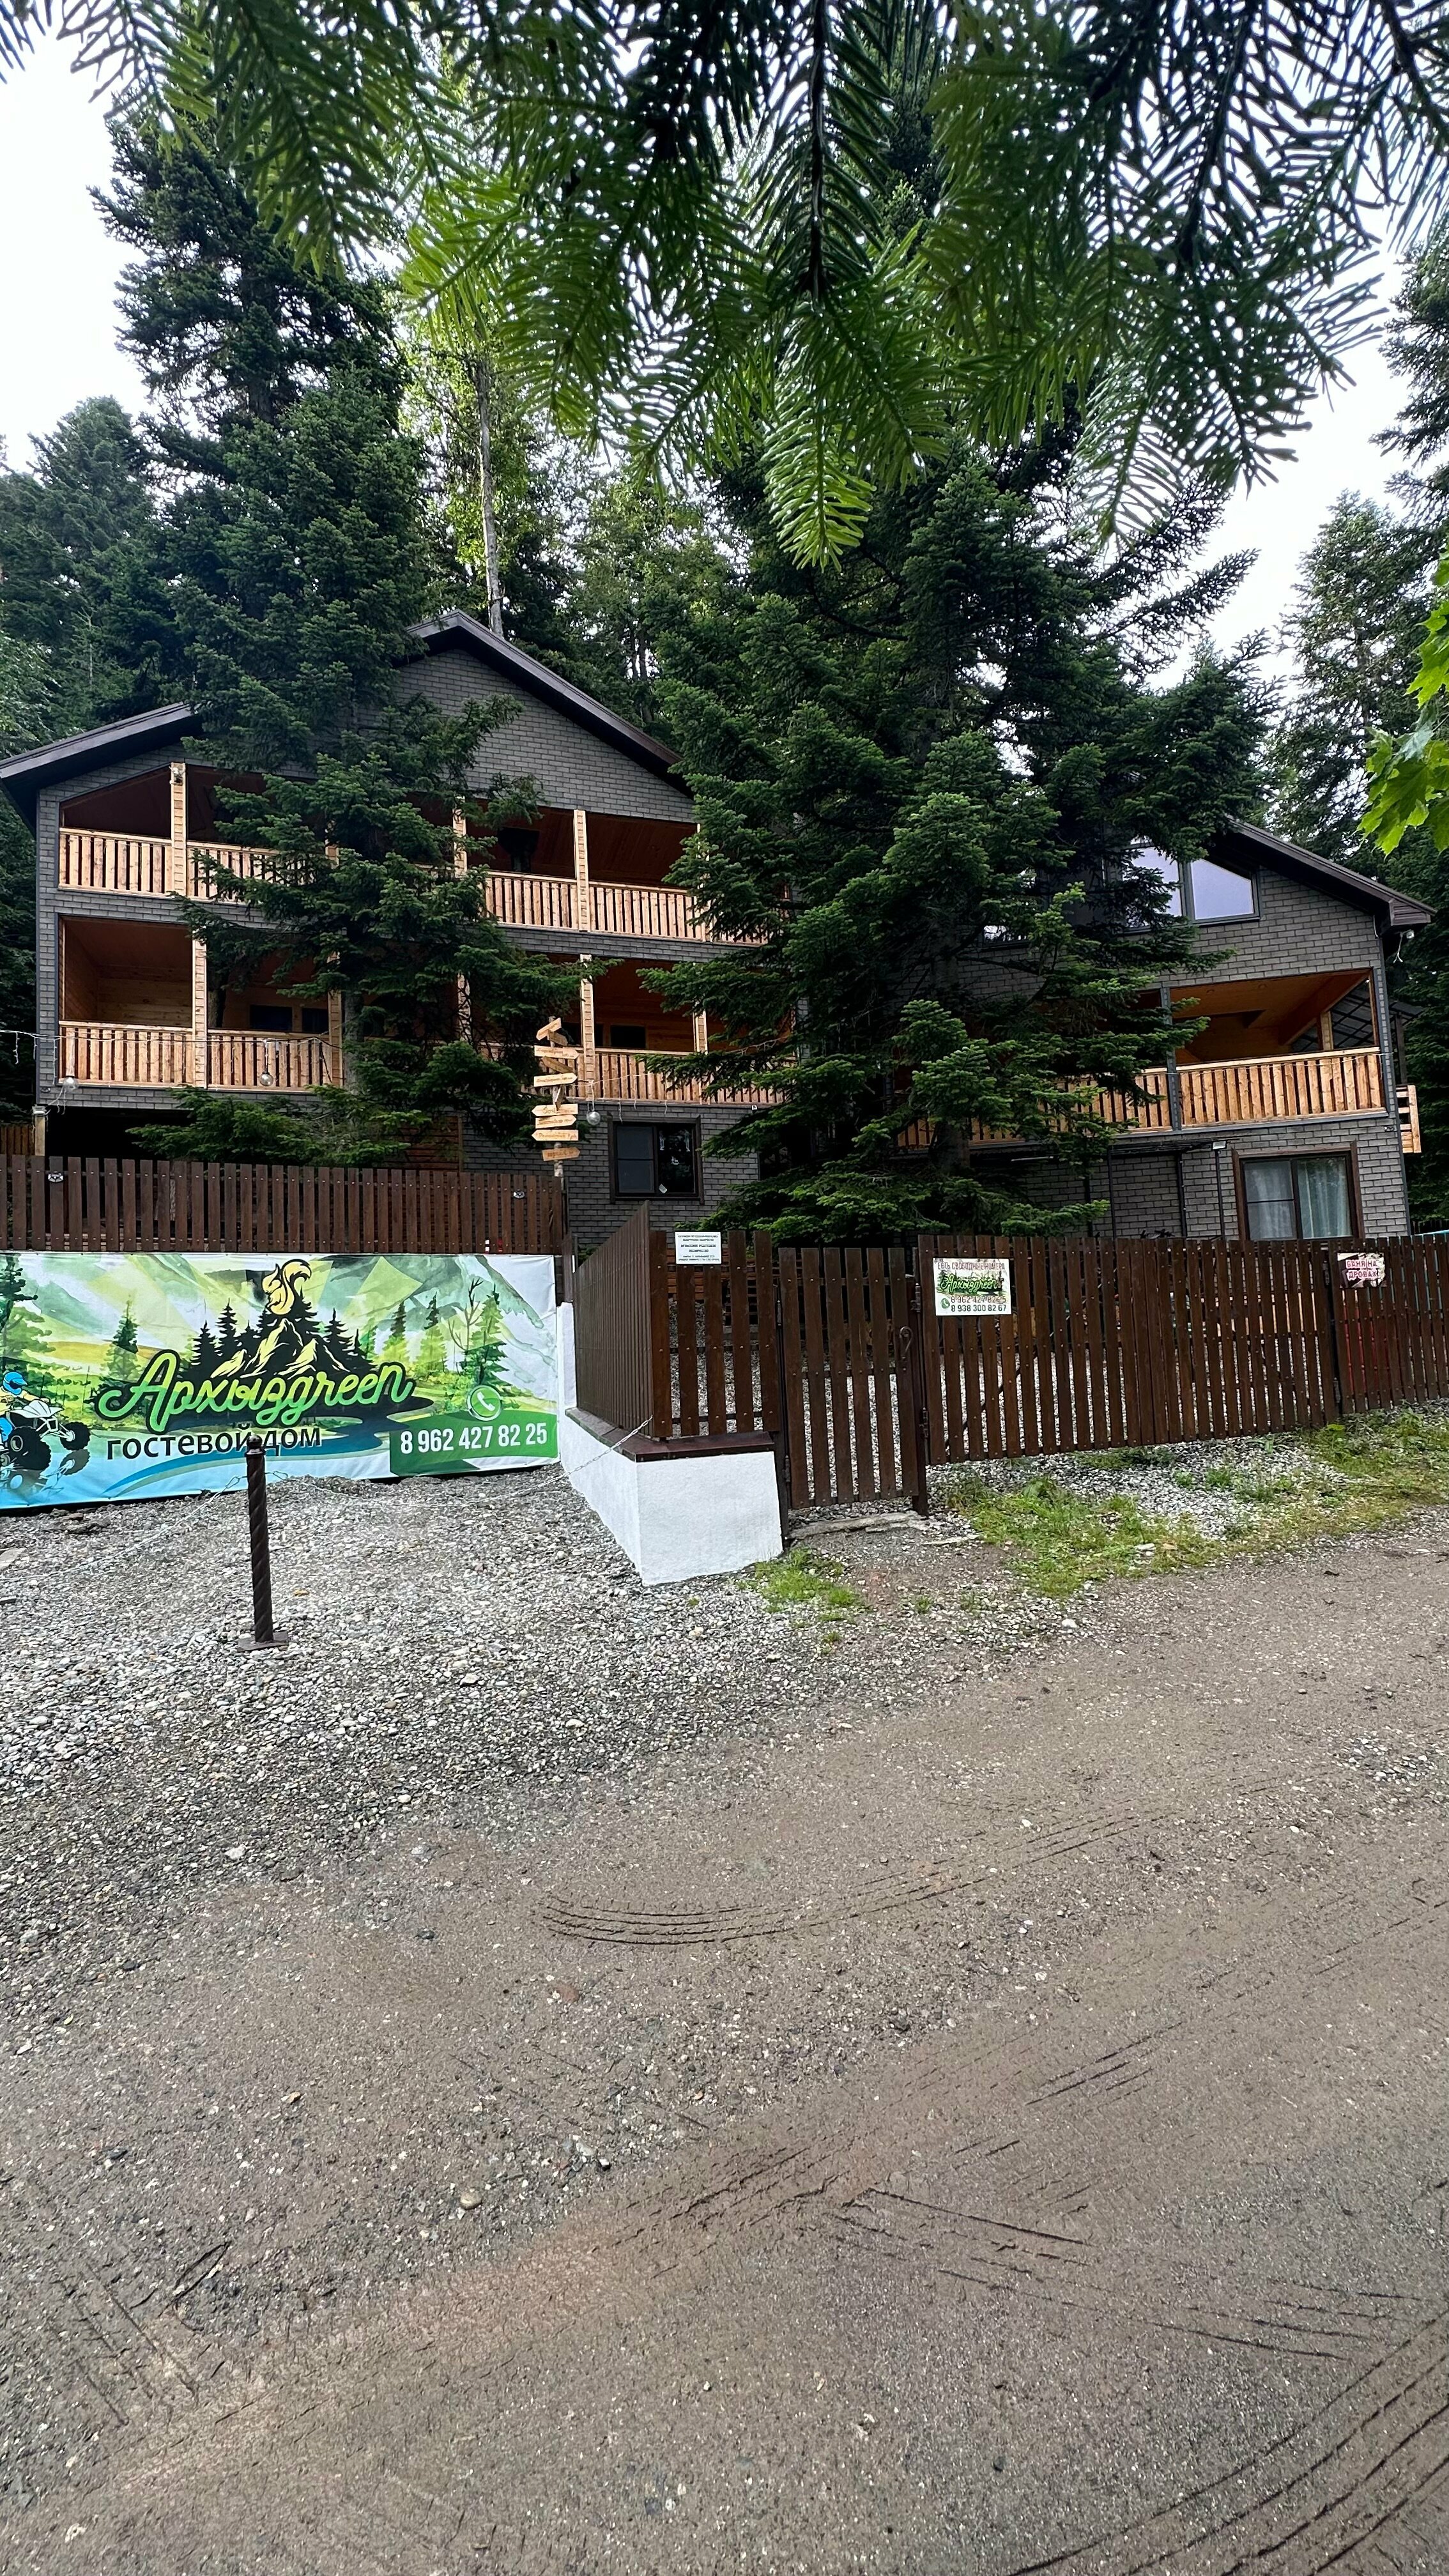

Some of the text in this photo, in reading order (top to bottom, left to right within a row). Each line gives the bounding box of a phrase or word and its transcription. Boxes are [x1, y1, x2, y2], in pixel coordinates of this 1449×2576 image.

[938, 1262, 951, 1270] ЕСТЬ
[952, 1262, 983, 1271] СВОБОДНЫЕ
[96, 1348, 414, 1434] Архызgreen
[401, 1422, 548, 1454] 8 962 427 82 25
